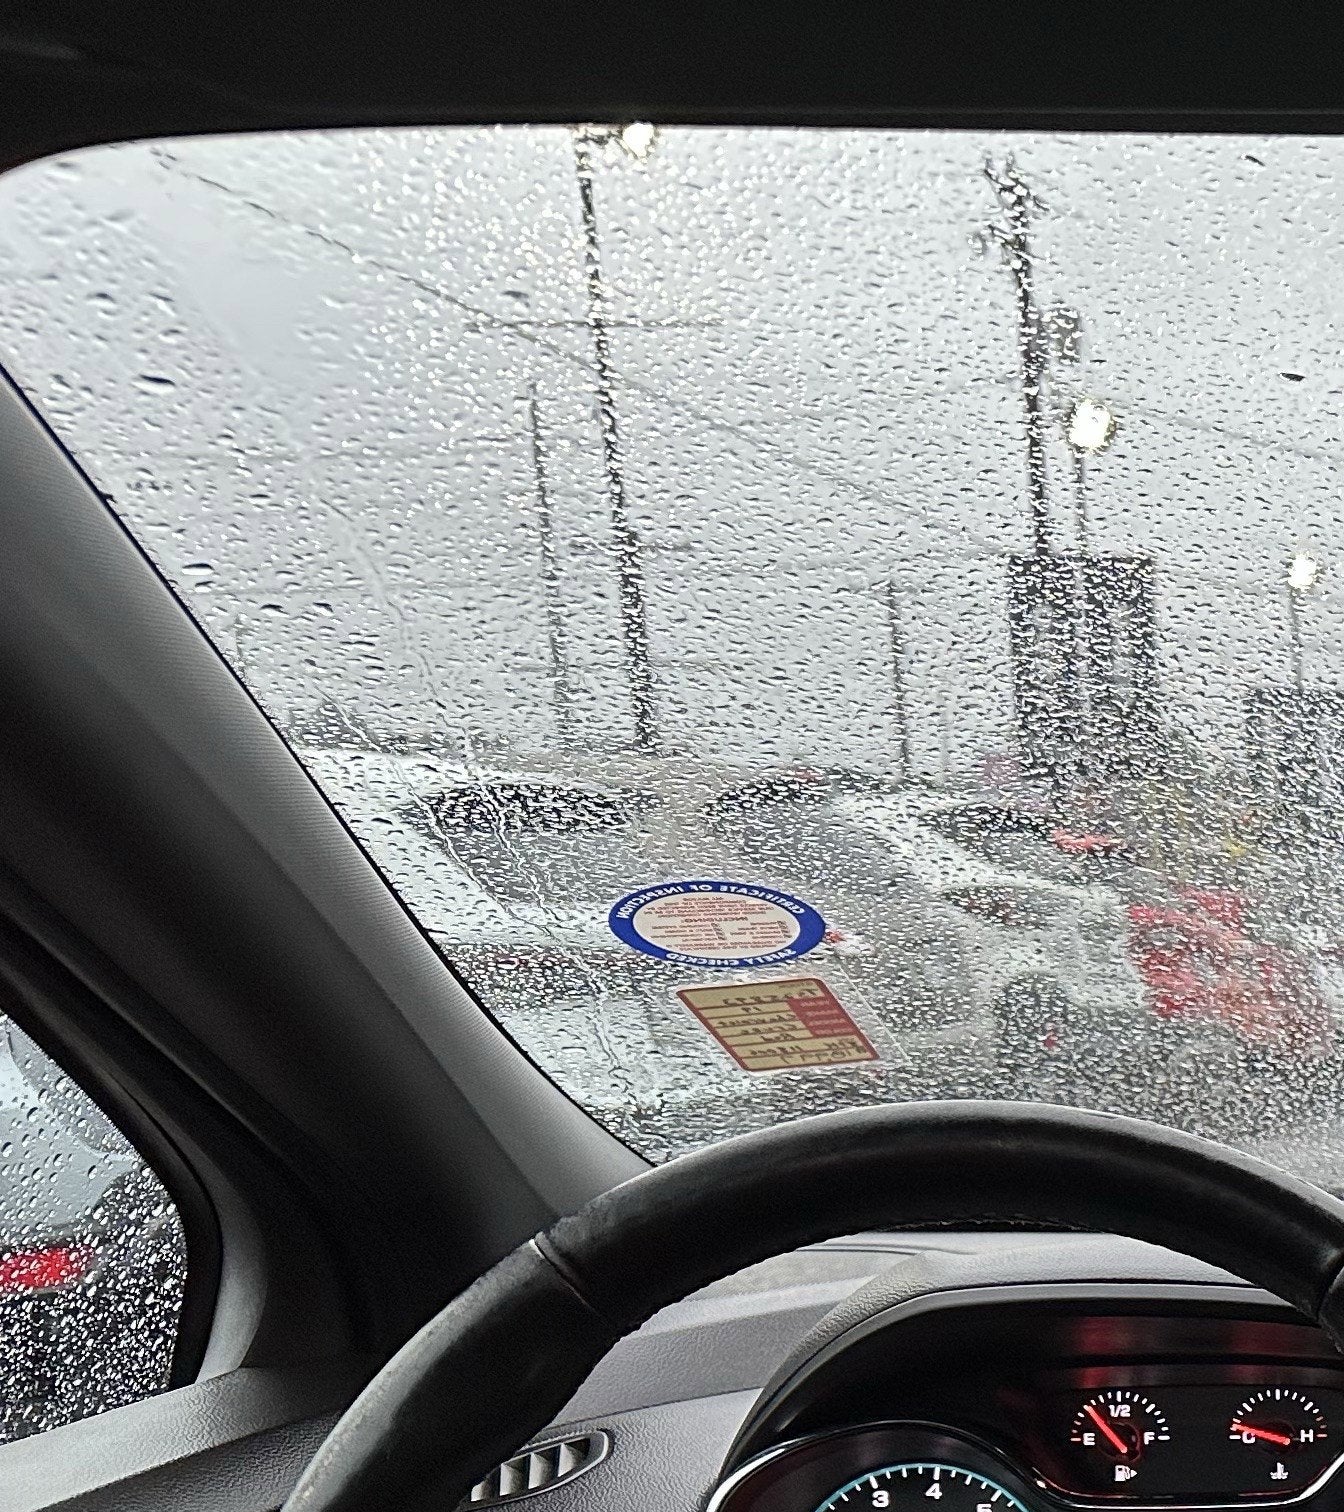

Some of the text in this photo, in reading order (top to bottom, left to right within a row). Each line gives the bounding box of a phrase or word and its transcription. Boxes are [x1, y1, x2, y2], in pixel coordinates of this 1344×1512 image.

[1108, 1404, 1131, 1417] 1/2
[1082, 1432, 1155, 1446] E F
[1300, 1429, 1314, 1443] H
[924, 1482, 943, 1499] 4
[872, 1490, 890, 1508] 3
